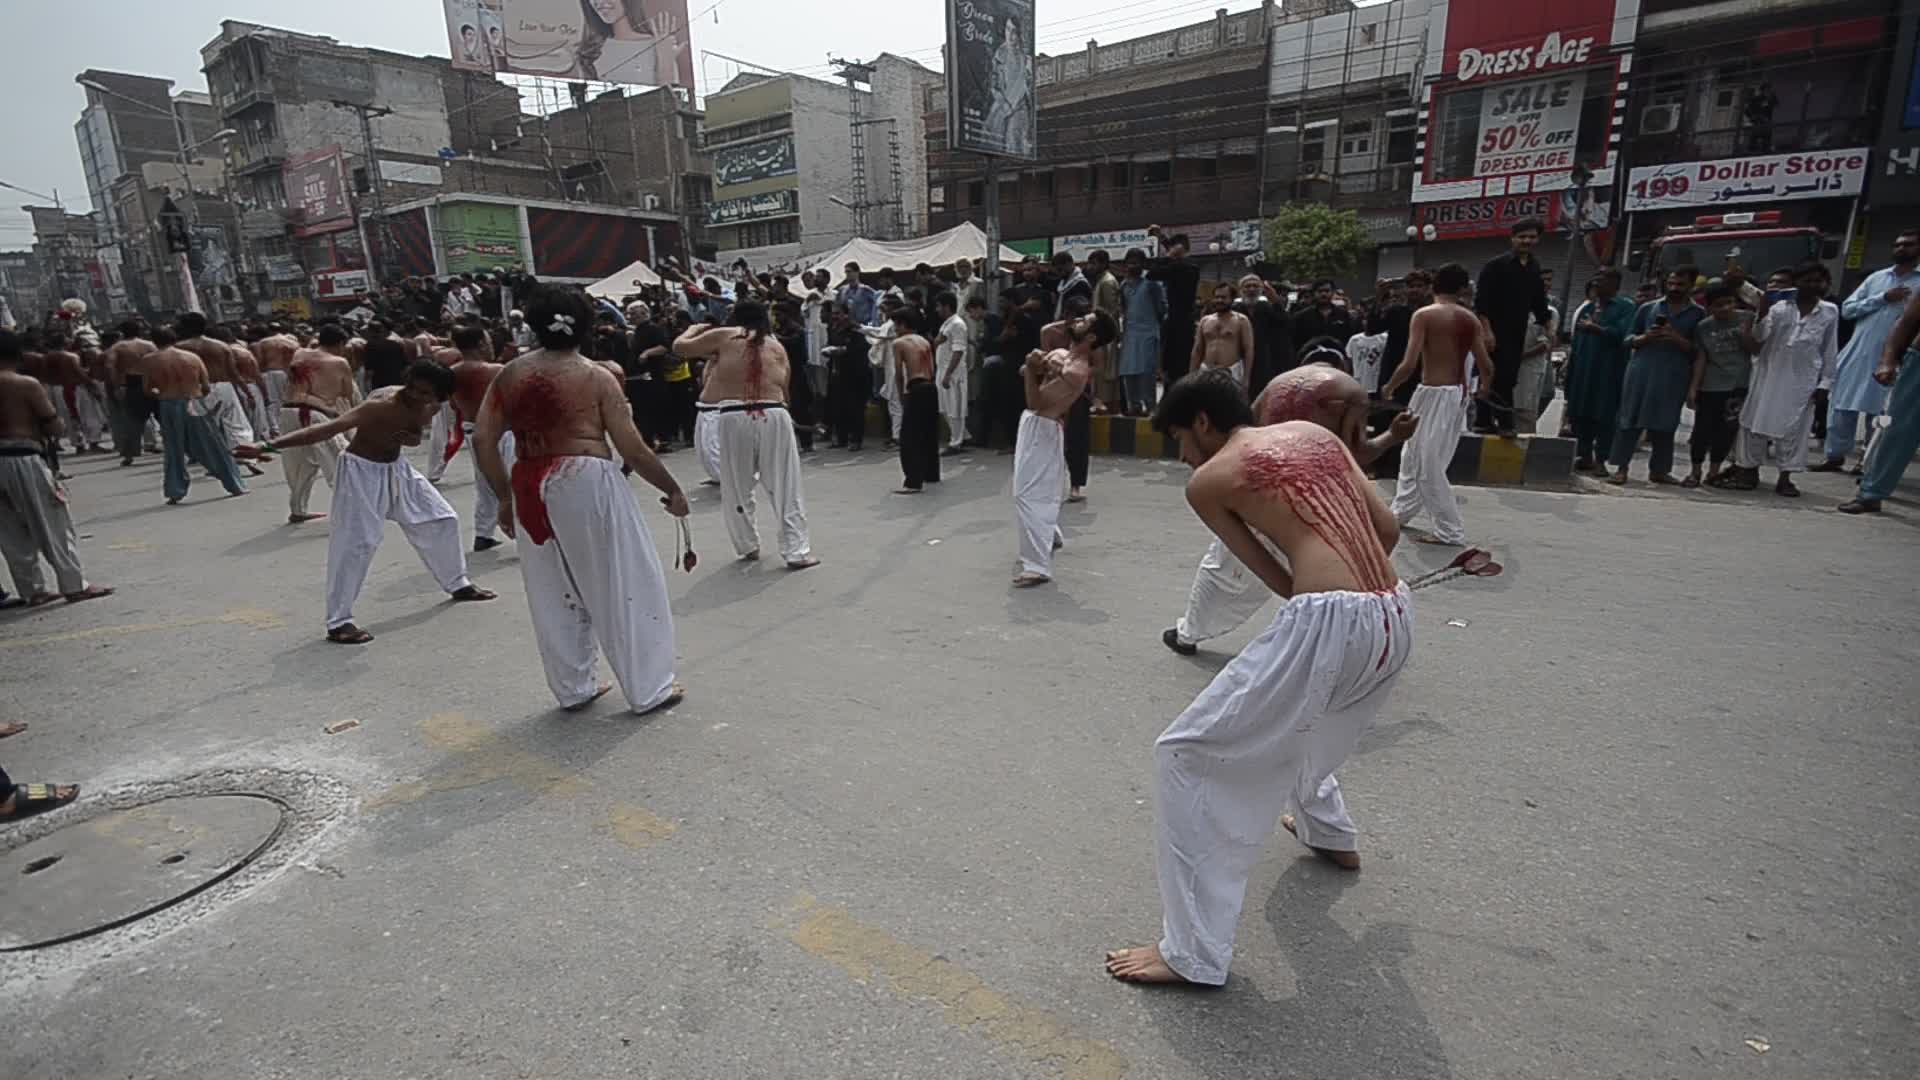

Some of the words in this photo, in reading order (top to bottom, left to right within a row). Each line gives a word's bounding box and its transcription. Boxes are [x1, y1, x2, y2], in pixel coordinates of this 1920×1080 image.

[1491, 81, 1574, 116] SALE
[1481, 122, 1540, 154] 50%
[1545, 129, 1574, 145] OFF
[1480, 155, 1531, 173] DRESS
[1534, 151, 1569, 167] AGE
[1697, 161, 1780, 182] Dollar
[1784, 156, 1864, 175] Store
[1631, 175, 1690, 199] 199
[1423, 201, 1496, 224] DRESS
[1503, 196, 1549, 217] AGE
